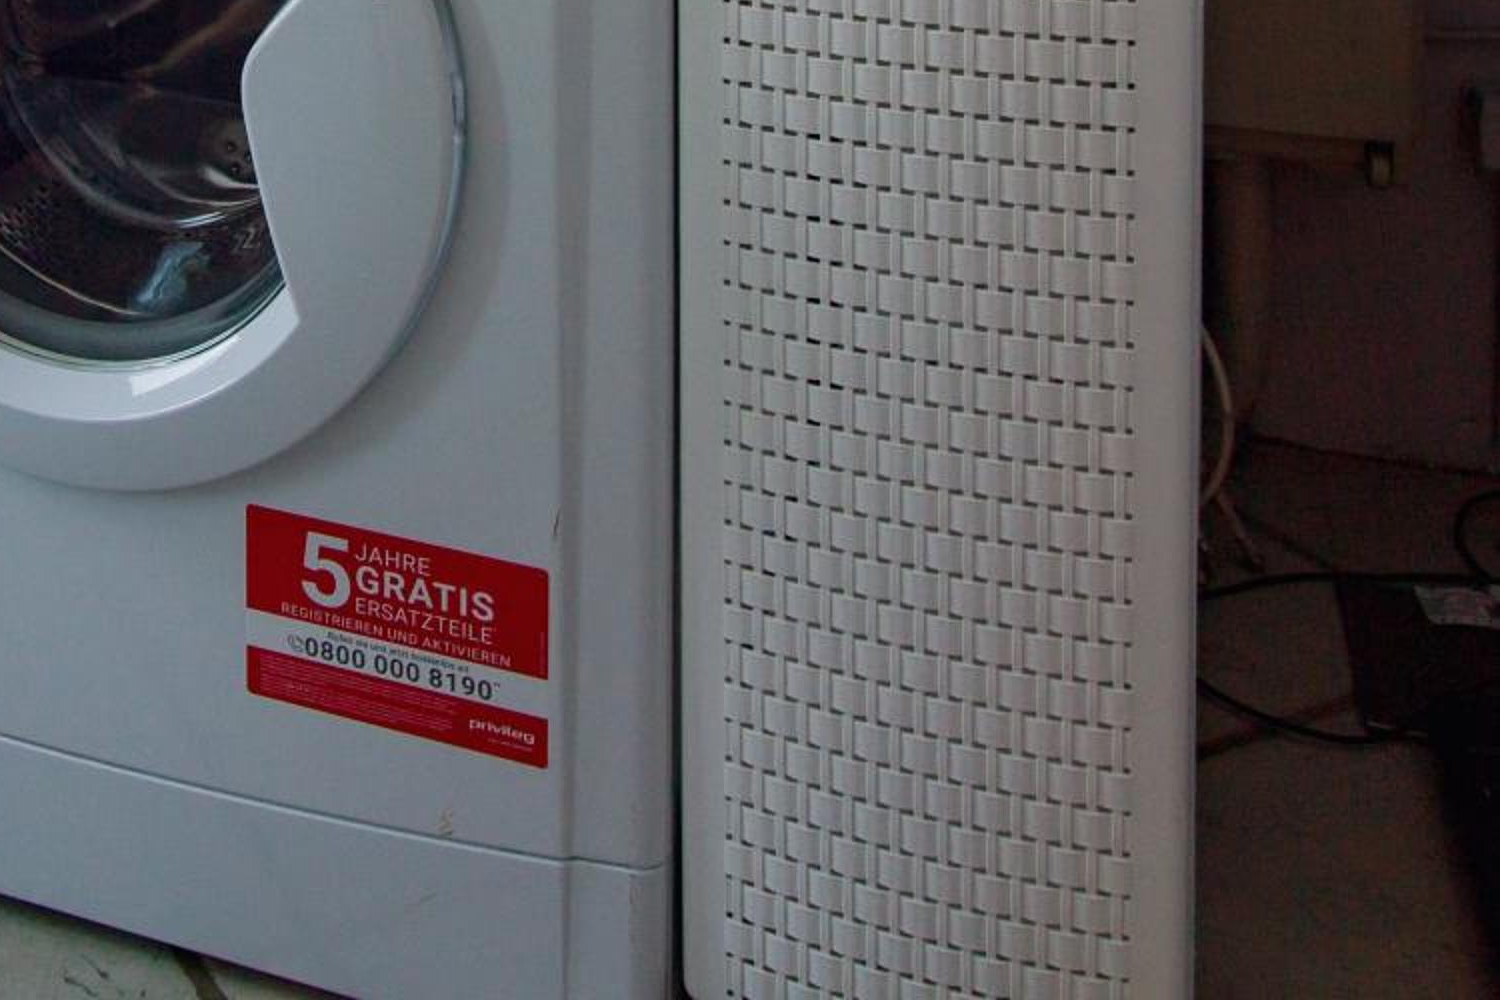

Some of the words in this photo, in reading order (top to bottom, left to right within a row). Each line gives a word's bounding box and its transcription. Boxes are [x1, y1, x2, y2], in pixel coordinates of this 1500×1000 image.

[301, 531, 351, 609] 5
[355, 543, 431, 577] JAHRE
[355, 566, 496, 622] GRATIS
[281, 601, 384, 638] REGISTRIEREN
[387, 629, 419, 646] UND
[421, 637, 512, 668] AKTIVIEREN
[304, 637, 367, 670] 0800
[373, 654, 421, 684] 000
[469, 719, 536, 746] privileg
